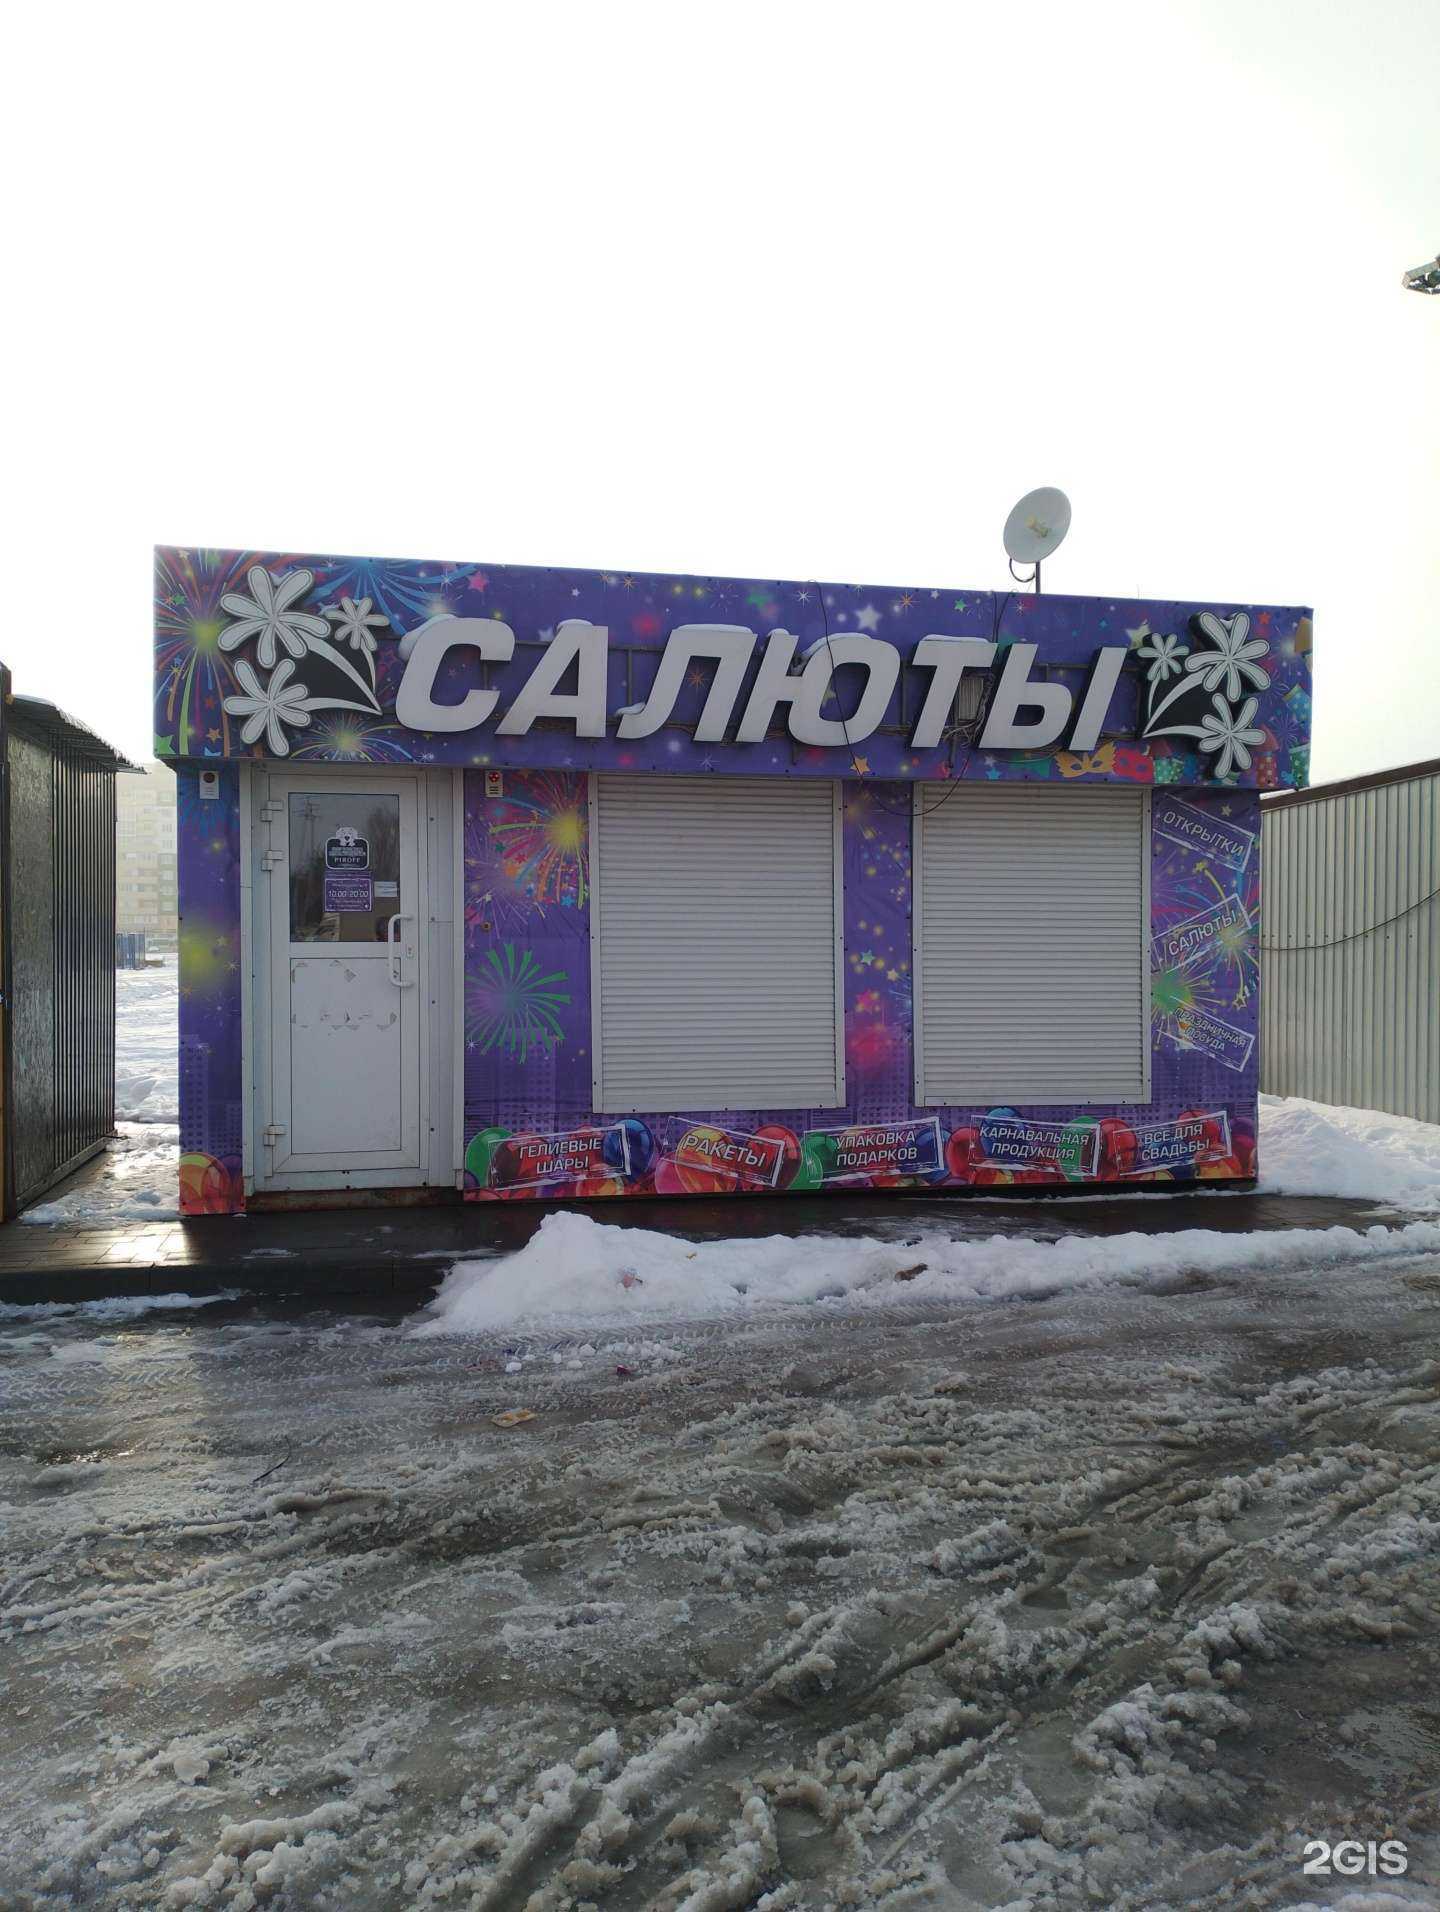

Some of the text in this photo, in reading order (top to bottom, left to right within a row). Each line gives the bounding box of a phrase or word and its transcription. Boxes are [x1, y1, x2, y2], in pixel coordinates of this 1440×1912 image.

[395, 616, 1127, 750] САЛЮТЫ
[1163, 811, 1245, 856] ОТКРЫТКИ
[1168, 910, 1237, 956] САЛЮТЫ
[1174, 1007, 1247, 1048] ПРАЗДНИЧНАЯ
[1185, 1027, 1226, 1051] ПОСУДА
[836, 1130, 916, 1150] УПАКОВКА
[979, 1126, 1090, 1145] КАРНАВАЛЬНАЯ
[1144, 1124, 1203, 1145] ВСЕ ДЛЯ
[519, 1137, 602, 1160] ГЕЛИЕВЫЕ
[682, 1134, 766, 1167] РАКЕТЫ
[837, 1147, 918, 1167] ПОДАРКОВ
[991, 1143, 1076, 1160] ПРОДУКЦИЯ
[1141, 1139, 1210, 1161] СВАДЬБЫ
[536, 1155, 590, 1175] ШАРЫ
